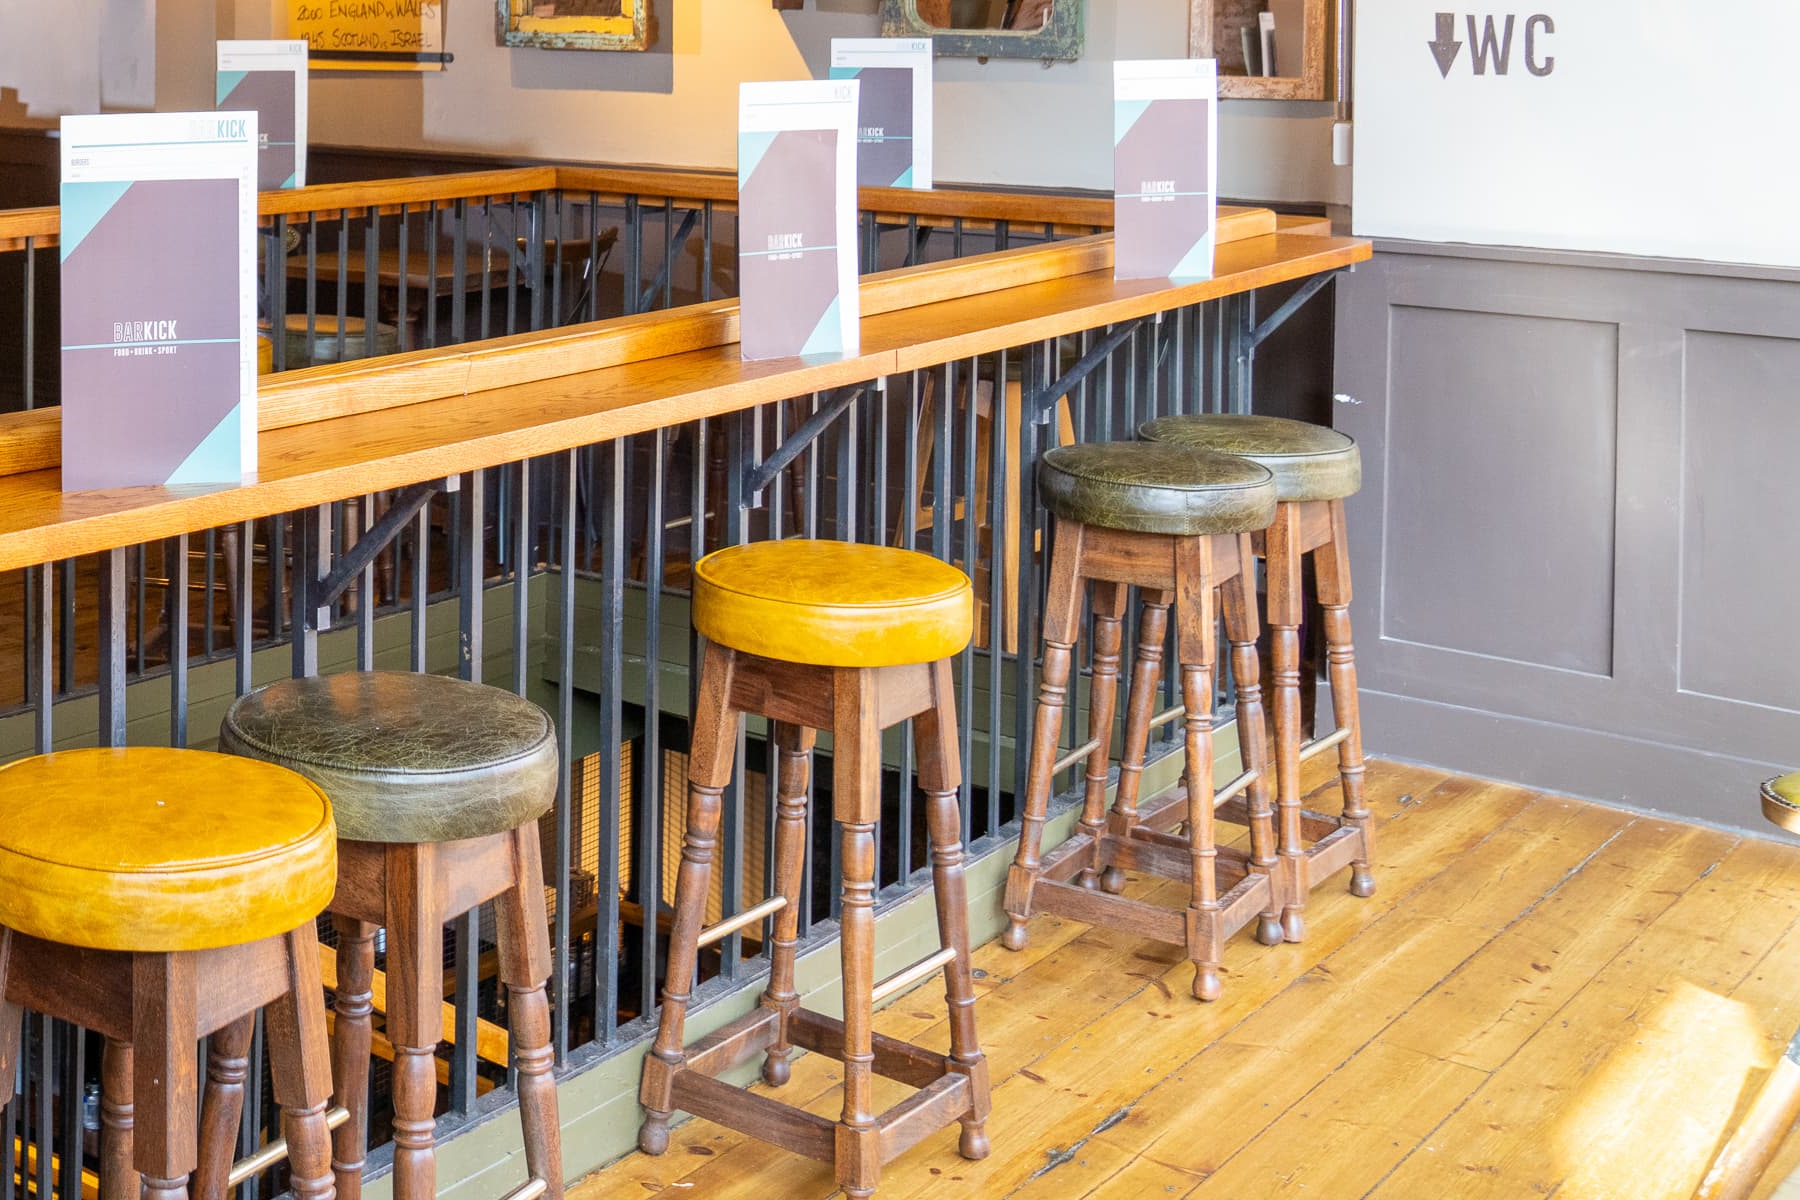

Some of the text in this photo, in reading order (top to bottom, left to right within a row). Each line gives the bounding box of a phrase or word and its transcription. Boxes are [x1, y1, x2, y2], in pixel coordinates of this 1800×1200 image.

[329, 0, 385, 22] ENGLAND
[332, 28, 380, 49] SCOTLAND
[391, 29, 433, 48] ISRAEL
[1466, 13, 1555, 77] WC
[113, 319, 177, 342] BARKICK
[157, 345, 177, 355] SPORT
